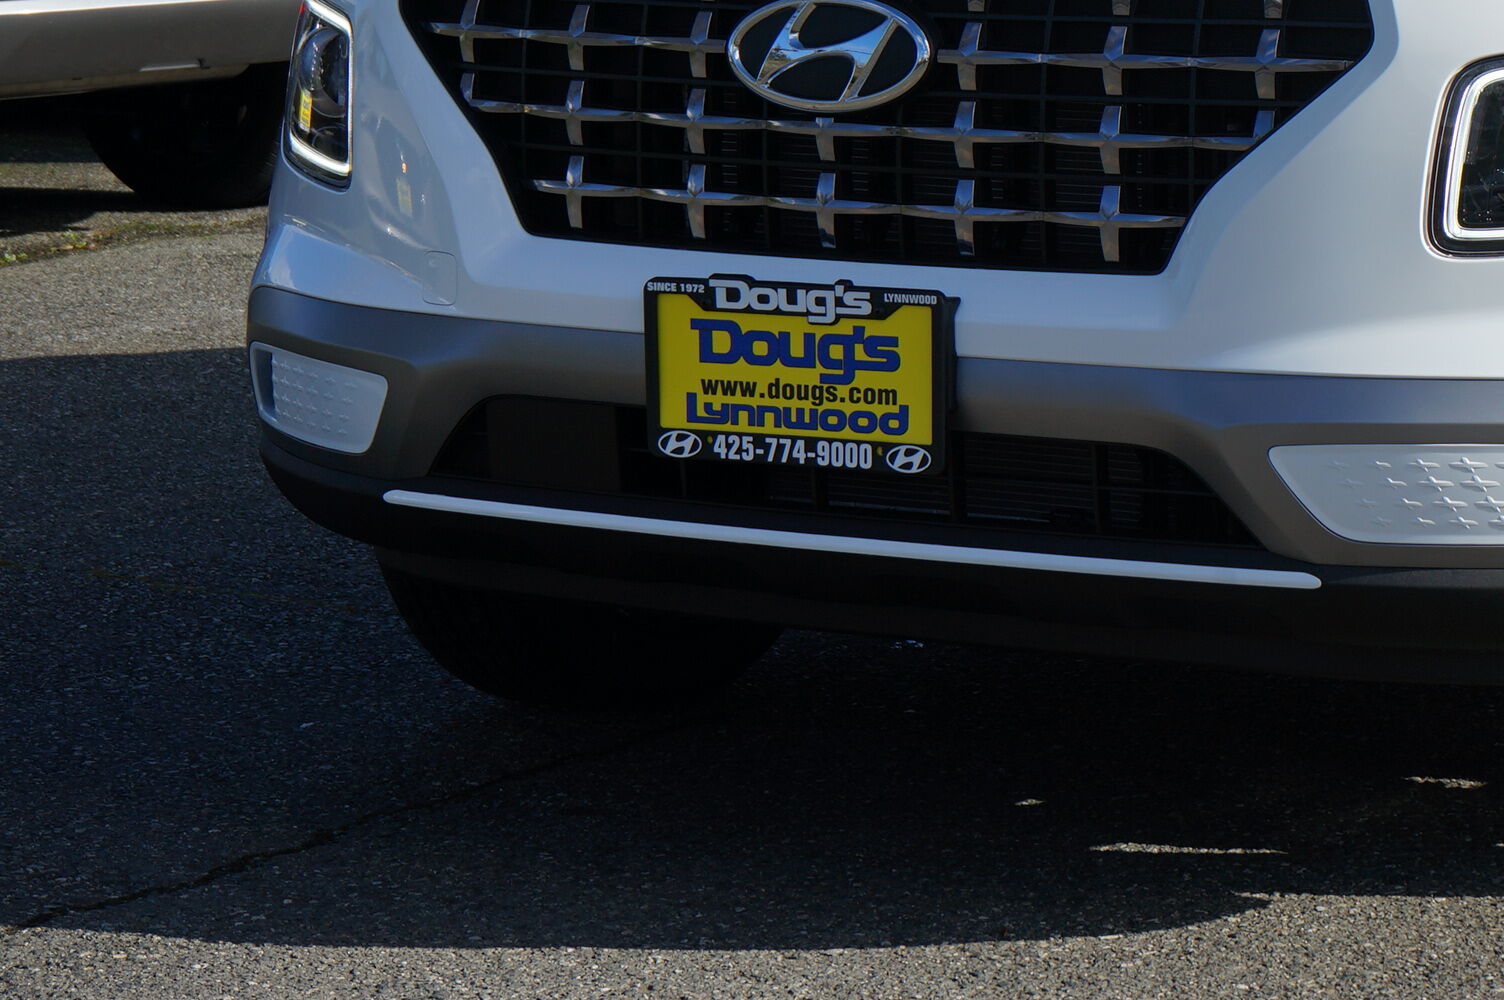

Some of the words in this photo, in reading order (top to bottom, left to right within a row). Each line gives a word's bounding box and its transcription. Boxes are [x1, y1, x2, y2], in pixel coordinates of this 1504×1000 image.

[647, 282, 677, 292] SINCE
[680, 283, 704, 293] 1972
[708, 279, 872, 324] Doug's
[883, 292, 937, 305] LYNNWOOD
[690, 318, 901, 385] Doug's
[700, 378, 897, 406] www.dougs.com
[686, 392, 909, 435] Lynnwood
[713, 434, 872, 470] 425-774-9000
